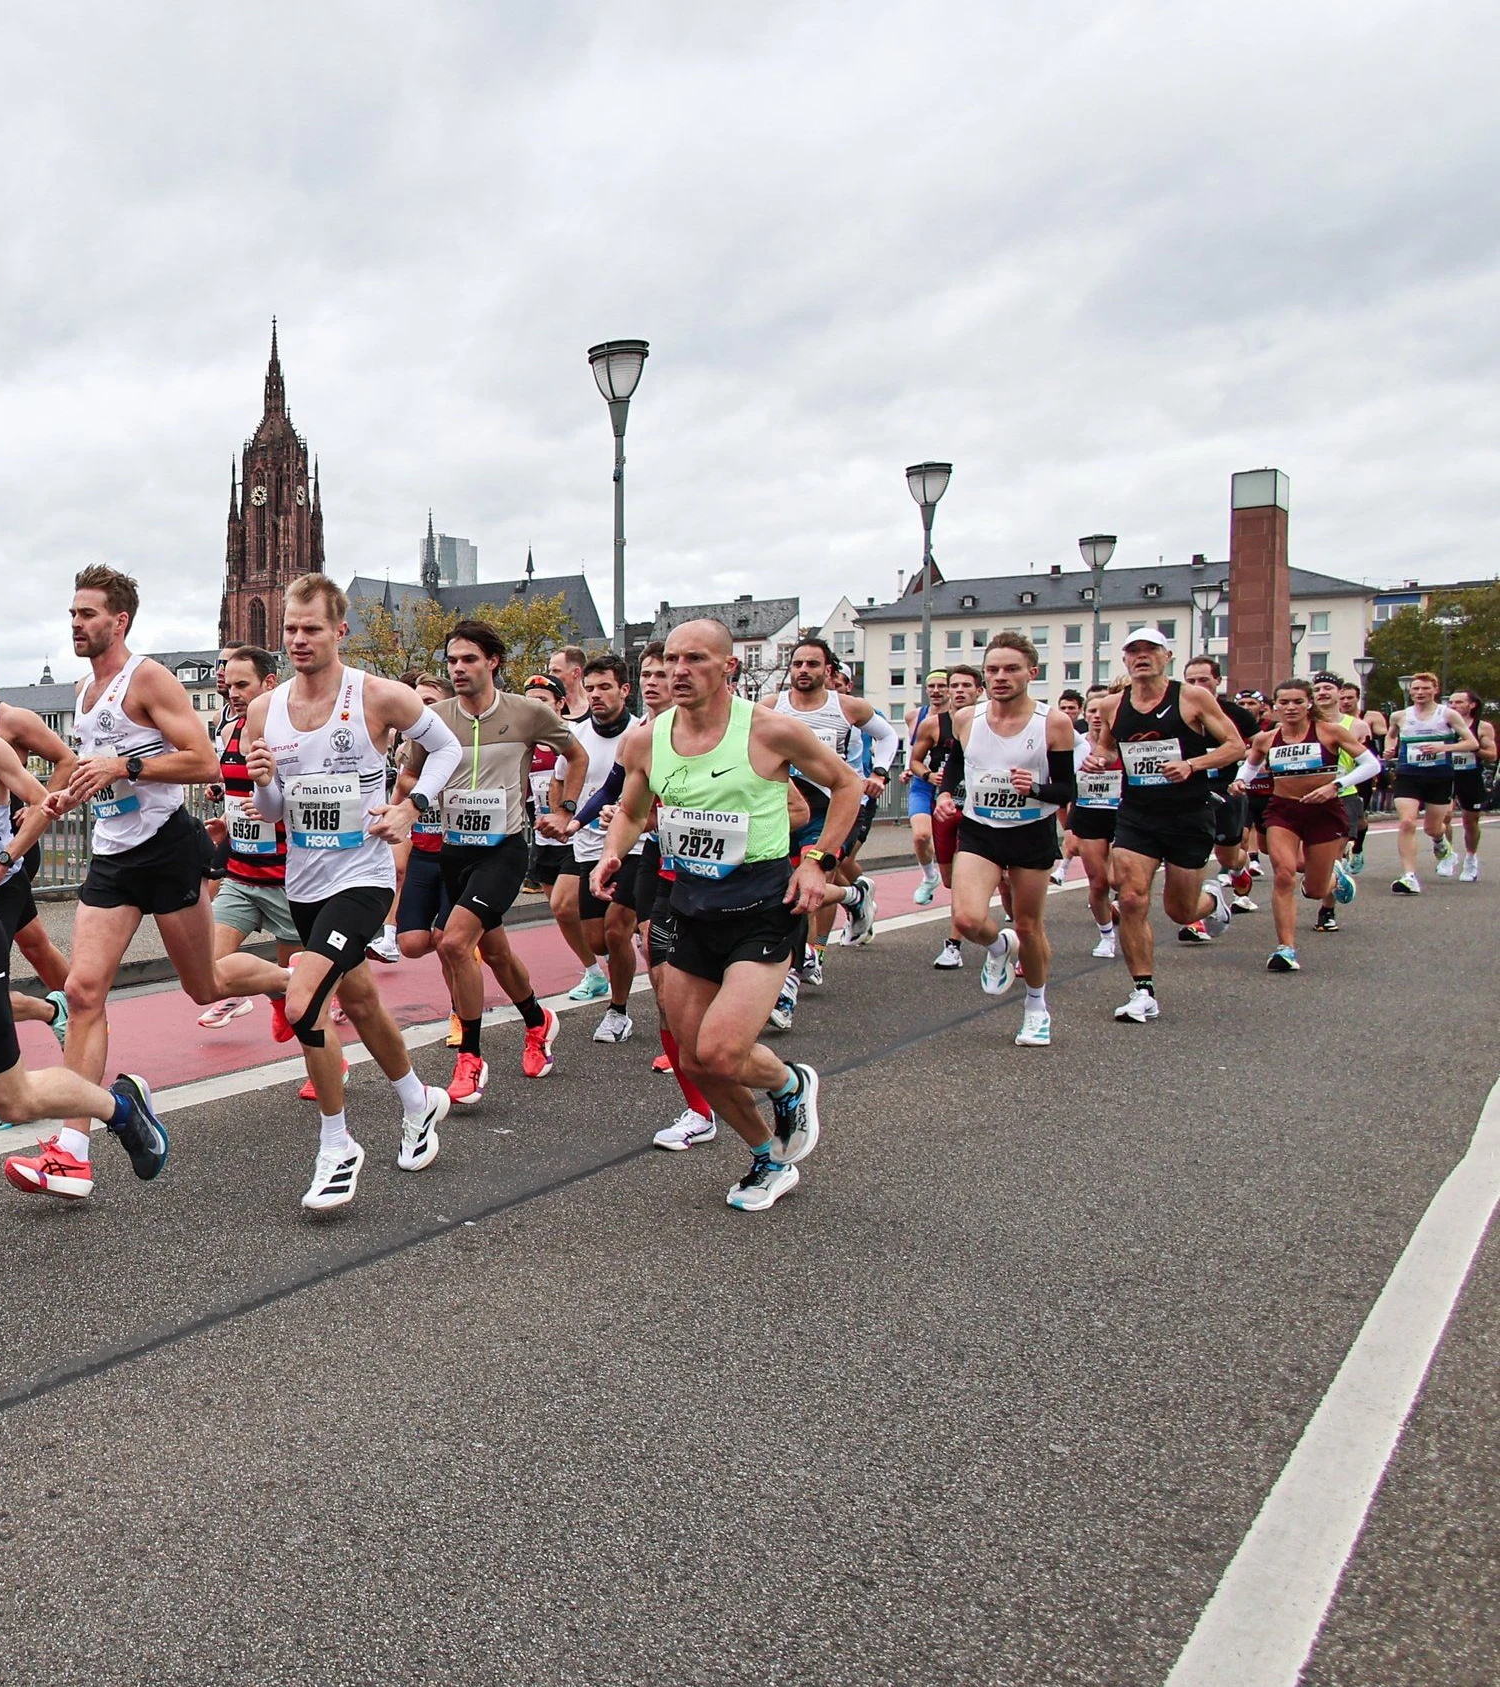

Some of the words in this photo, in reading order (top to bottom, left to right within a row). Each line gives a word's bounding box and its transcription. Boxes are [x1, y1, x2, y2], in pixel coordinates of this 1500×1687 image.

[343, 684, 353, 709] EXTRA
[1136, 745, 1174, 754] mainova
[1275, 744, 1312, 759] BREGJE
[302, 784, 352, 795] mainova
[1088, 783, 1110, 793] ANNA
[298, 801, 320, 810] Kristian
[321, 801, 341, 810] Riseth
[459, 796, 500, 805] mainova
[983, 792, 1027, 808] 12829
[100, 804, 121, 818] HOKA
[682, 810, 739, 824] mainova
[990, 810, 1021, 819] HOKA
[301, 809, 340, 831] 4189
[455, 814, 491, 831] 4386
[232, 821, 260, 840] 6930
[689, 827, 712, 836] Gaetan
[305, 835, 340, 847] HOKA
[460, 834, 488, 845] HOKA
[235, 842, 258, 853] HOKA
[678, 835, 725, 861] 2924
[684, 861, 720, 877] HOKA
